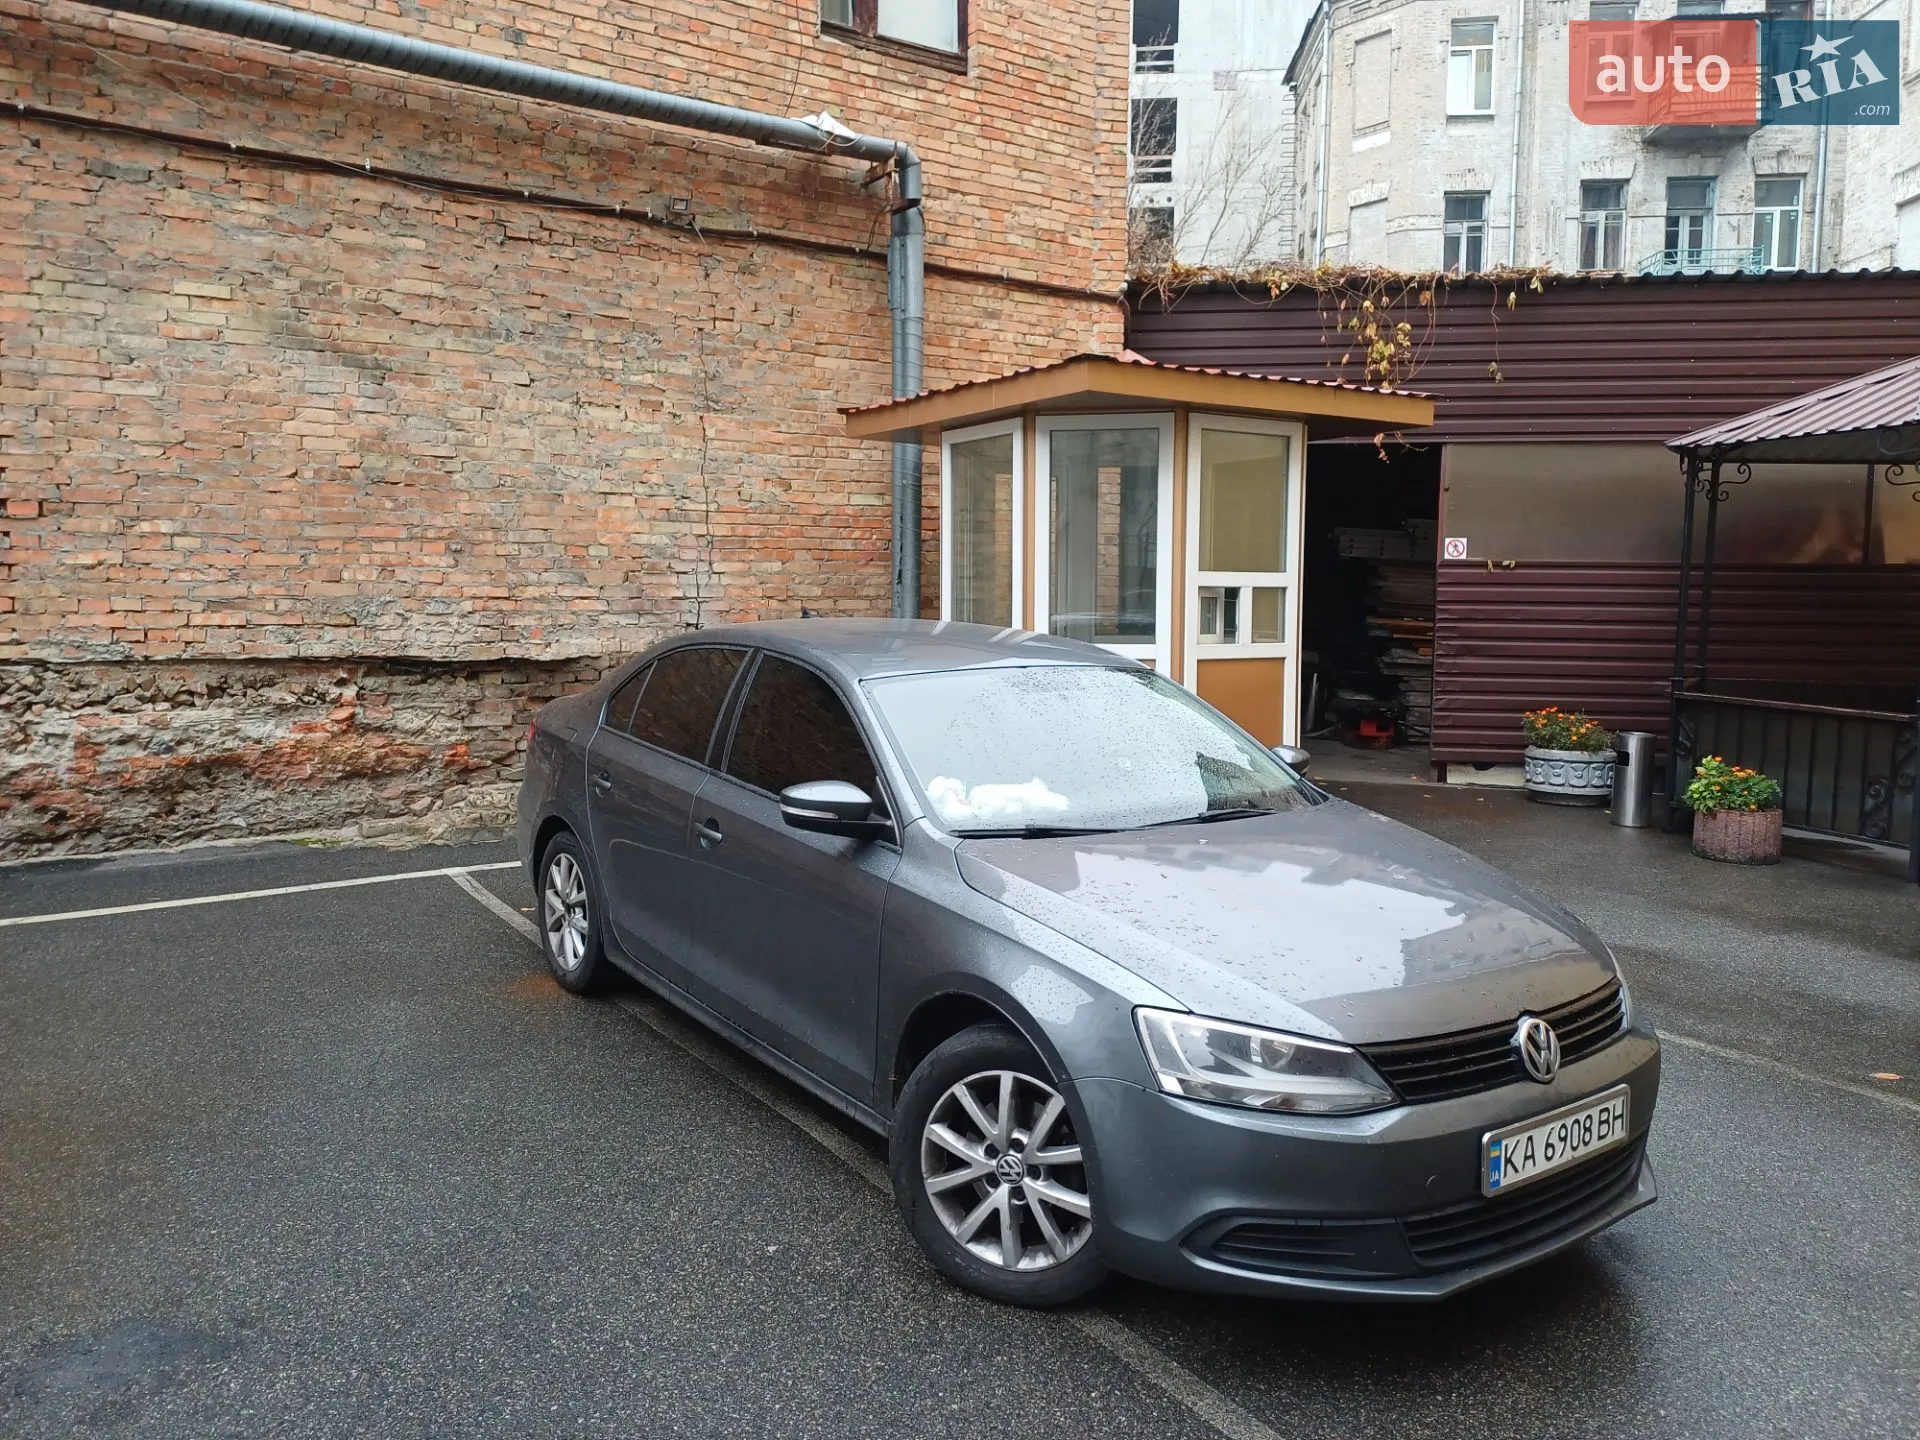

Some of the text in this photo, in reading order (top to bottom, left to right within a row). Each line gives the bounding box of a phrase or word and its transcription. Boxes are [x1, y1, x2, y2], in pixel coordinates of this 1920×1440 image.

[1503, 1099, 1625, 1178] KA 6908 BH
[1489, 1170, 1500, 1183] UA
